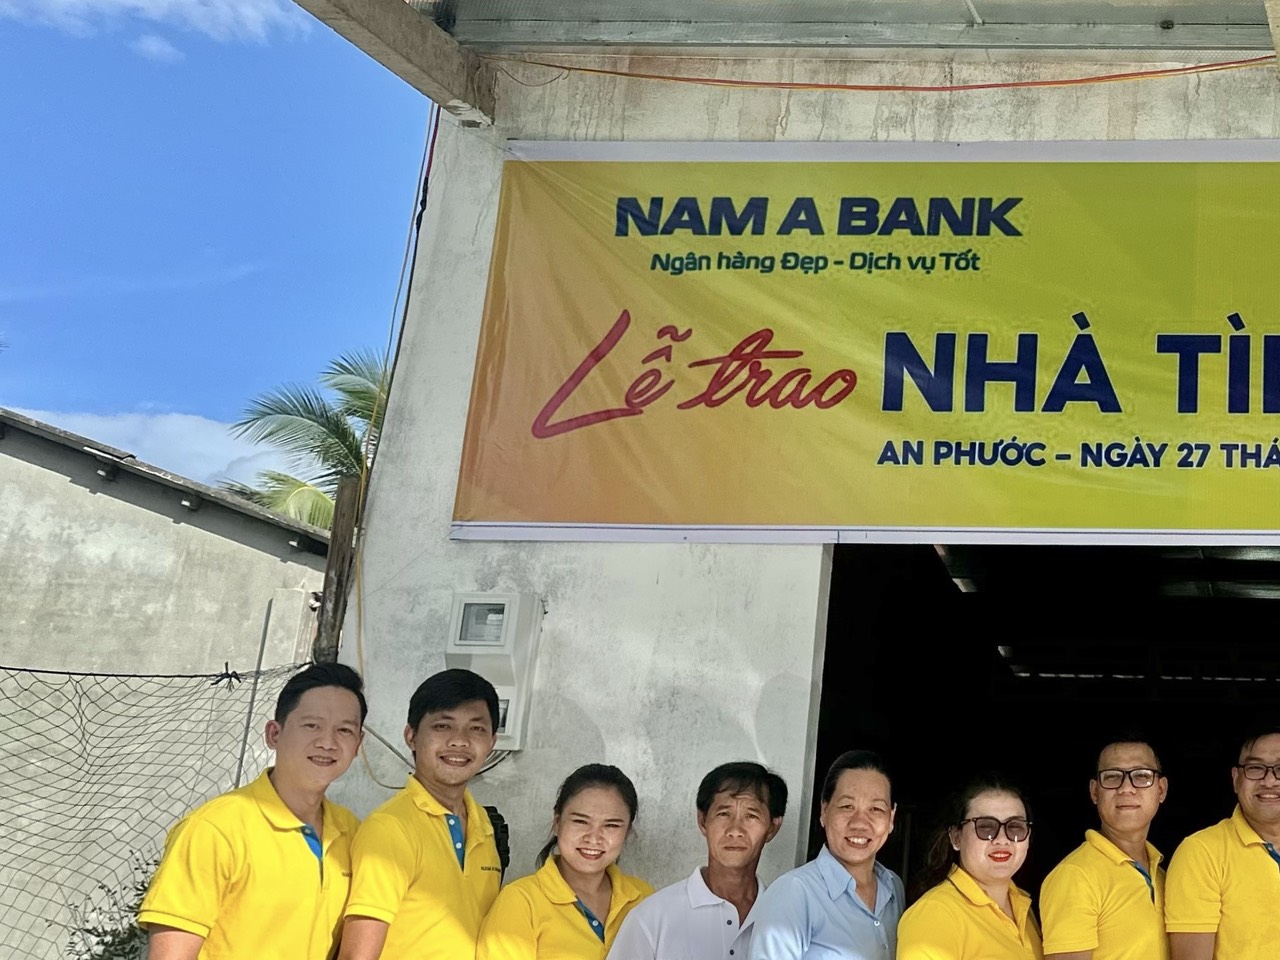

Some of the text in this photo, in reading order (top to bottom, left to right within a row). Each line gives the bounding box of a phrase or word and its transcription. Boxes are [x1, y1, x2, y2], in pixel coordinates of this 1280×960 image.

[614, 196, 1024, 238] NAM A BANK
[649, 251, 712, 276] Ngân
[716, 250, 775, 275] hàng
[780, 251, 829, 275] Đẹp
[849, 251, 902, 275] Dịch
[907, 255, 936, 275] vụ
[938, 248, 982, 271] Tốt
[531, 309, 858, 439] Lễ trao
[881, 311, 1123, 414] NHÀ
[876, 440, 924, 466] AN
[933, 435, 1047, 467] PHƯỚC
[1080, 436, 1169, 468] NGÀY
[1176, 442, 1211, 468] 27
